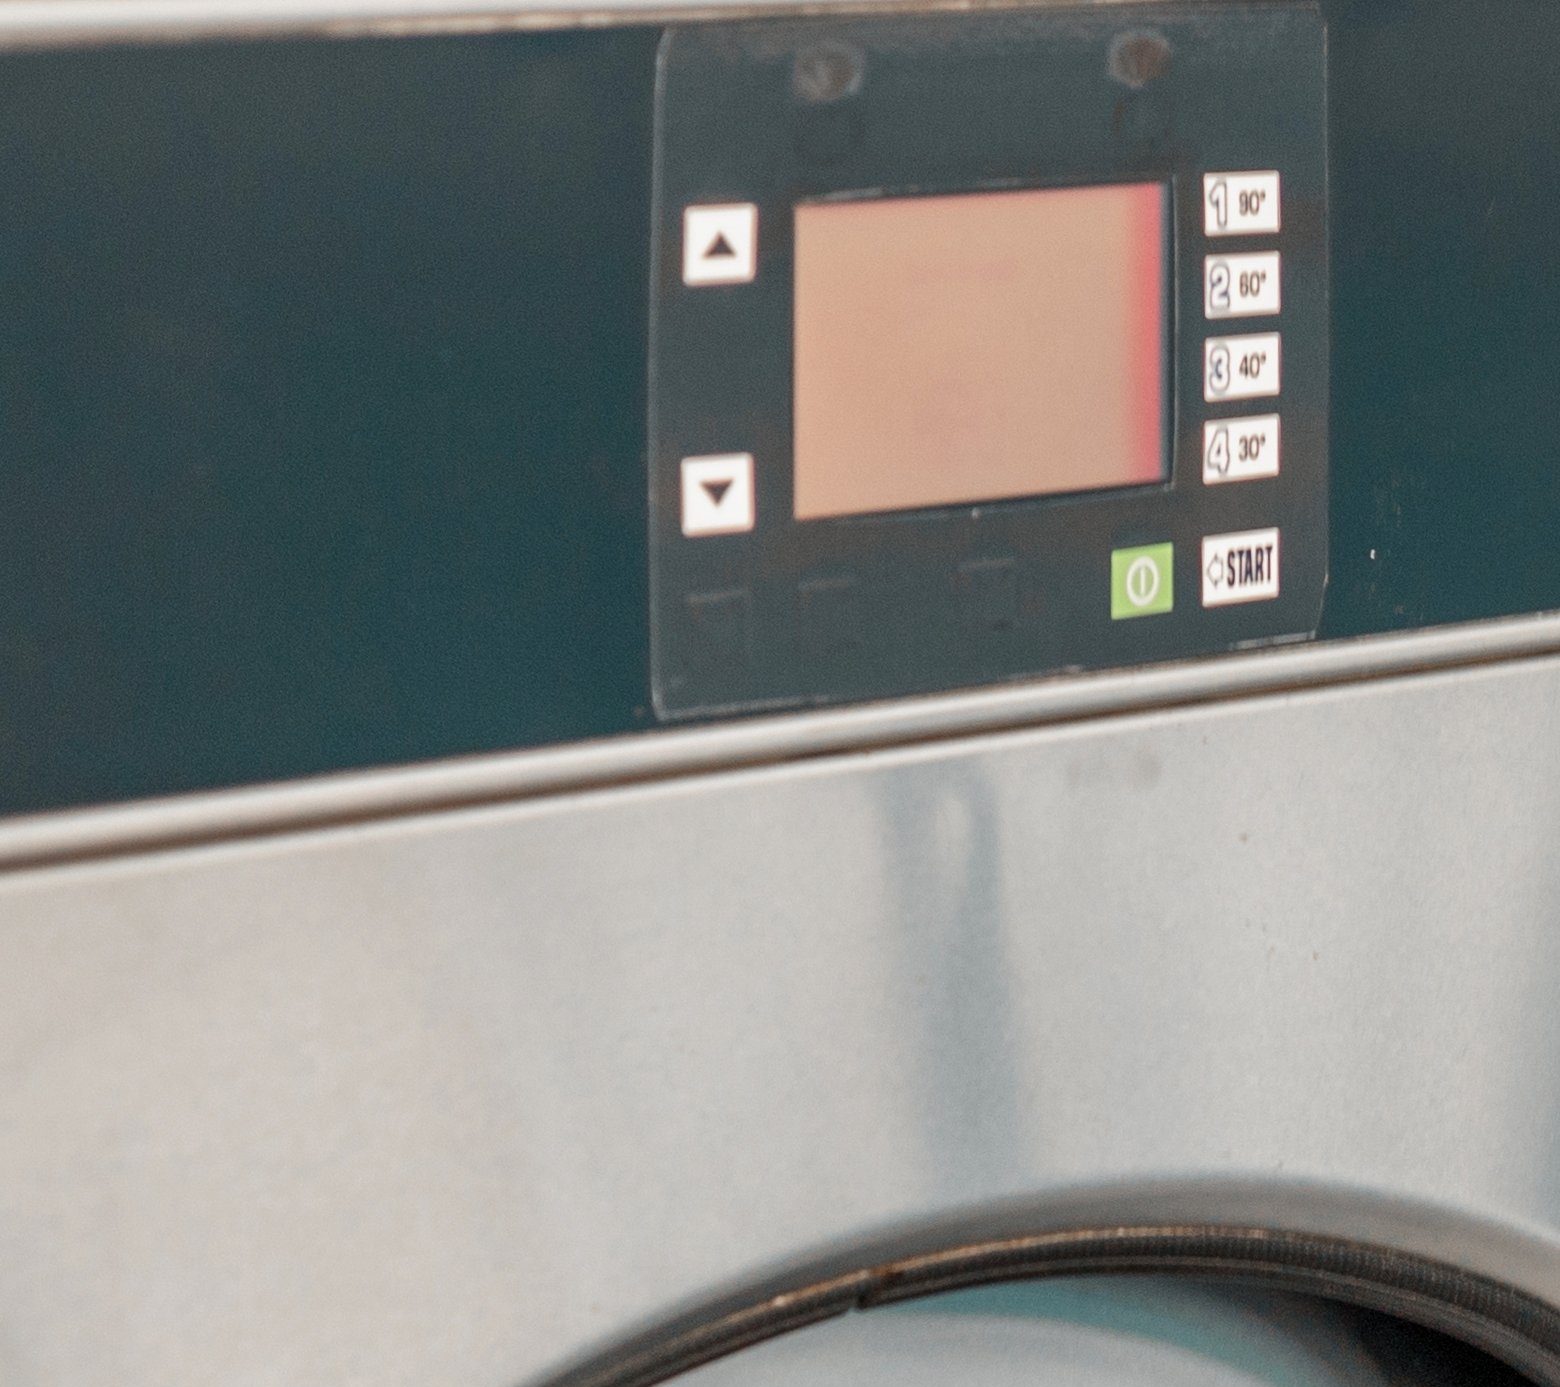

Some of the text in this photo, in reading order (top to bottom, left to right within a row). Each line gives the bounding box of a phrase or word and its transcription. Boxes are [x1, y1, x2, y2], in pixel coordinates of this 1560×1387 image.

[1209, 179, 1228, 230] 1
[1209, 260, 1231, 308] 2
[1209, 343, 1230, 395] 3
[1207, 424, 1230, 477] 4
[1227, 545, 1273, 588] START
